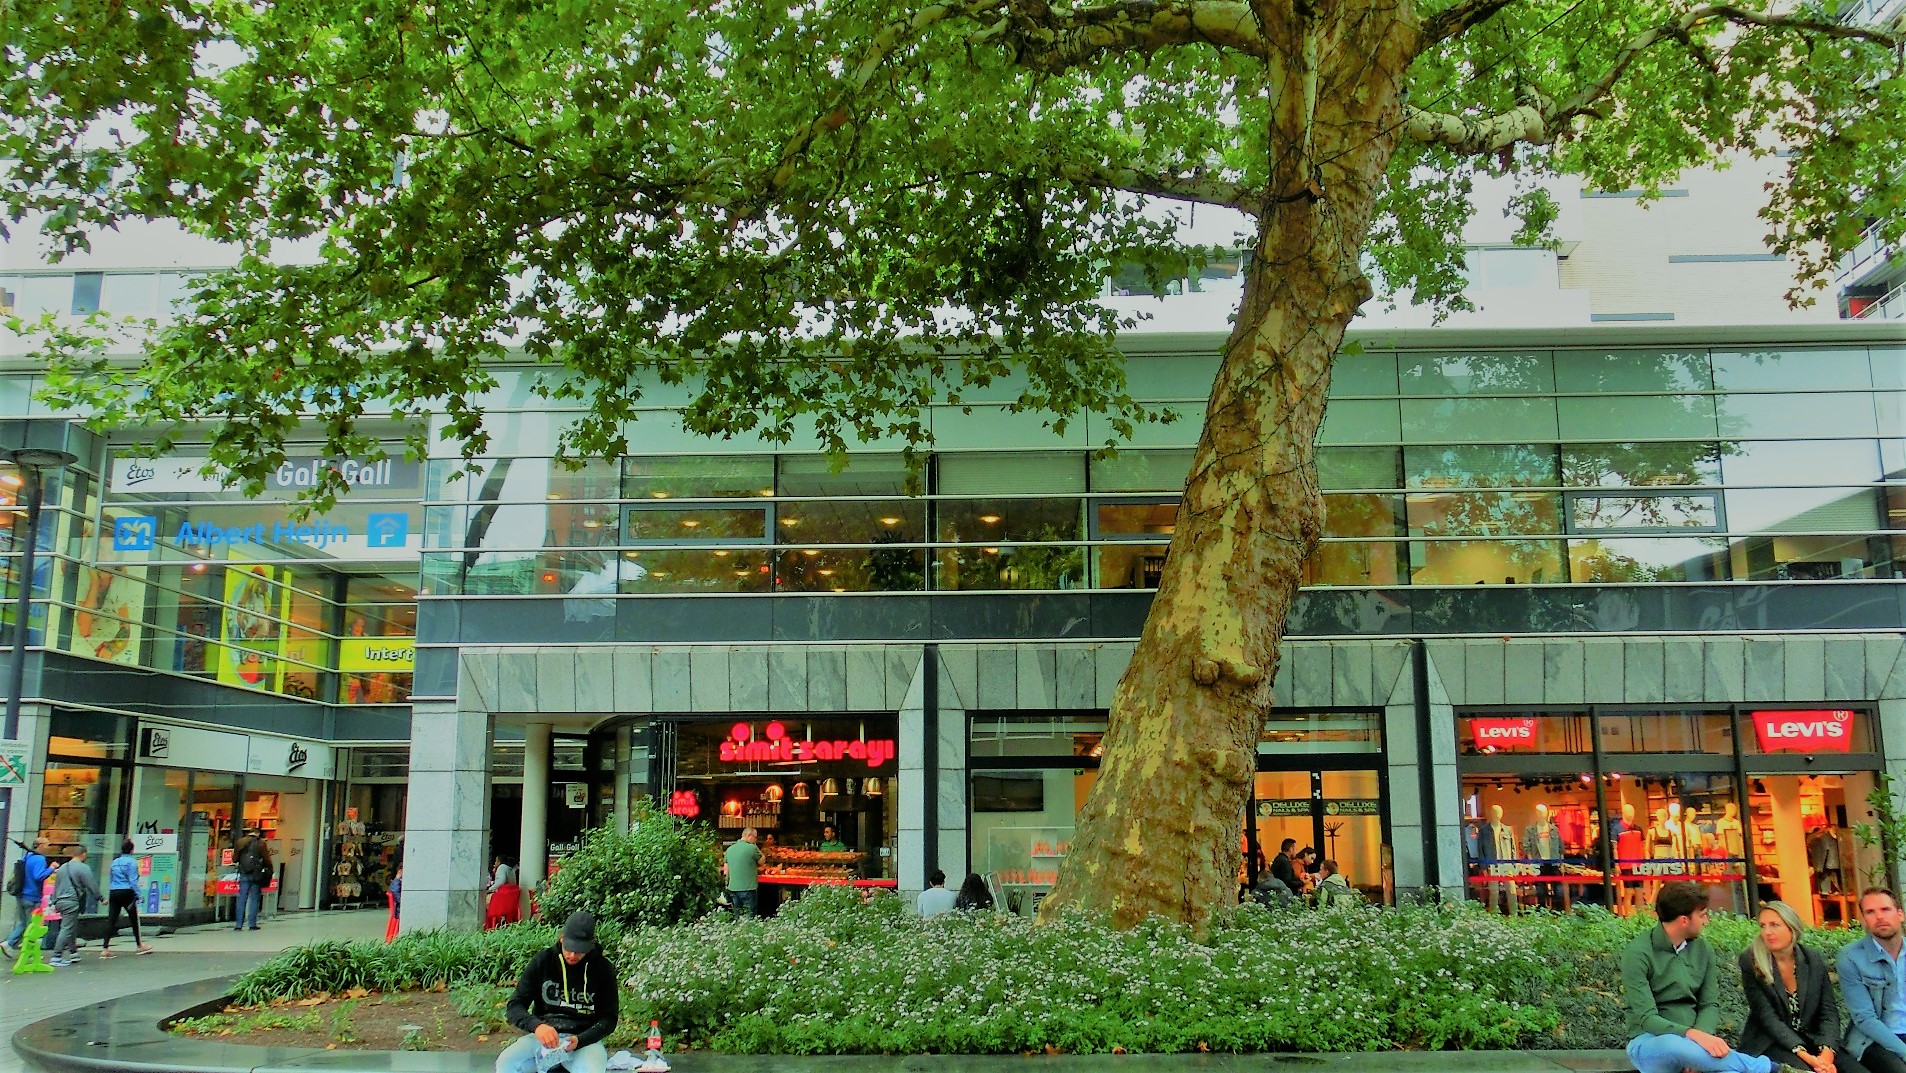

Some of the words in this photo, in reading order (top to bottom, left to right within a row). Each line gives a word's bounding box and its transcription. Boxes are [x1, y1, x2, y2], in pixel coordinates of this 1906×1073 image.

[126, 463, 156, 486] Etos
[341, 459, 391, 486] Gall
[175, 521, 266, 546] Albert
[273, 520, 348, 549] Heijn
[364, 645, 416, 663] Intert
[719, 721, 794, 762] simit
